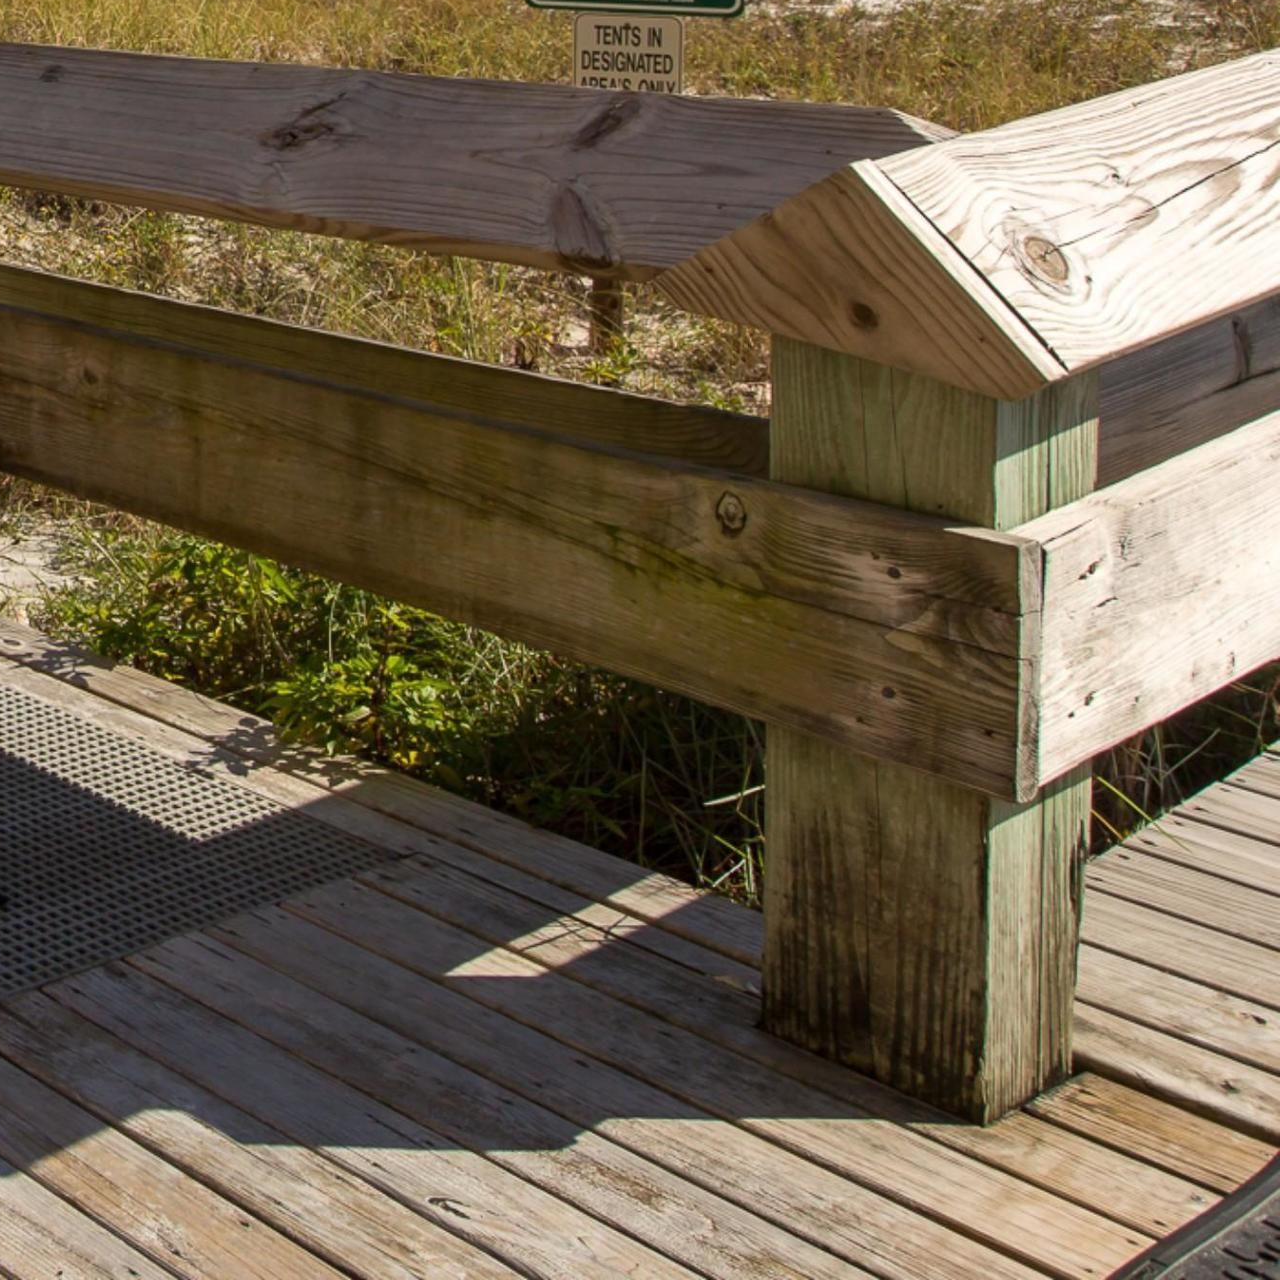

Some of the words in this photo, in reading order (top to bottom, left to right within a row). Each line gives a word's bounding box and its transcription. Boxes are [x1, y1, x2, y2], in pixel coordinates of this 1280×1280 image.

[594, 25, 641, 46] TENTS
[647, 27, 663, 48] IN
[581, 50, 674, 74] DESIGNATED
